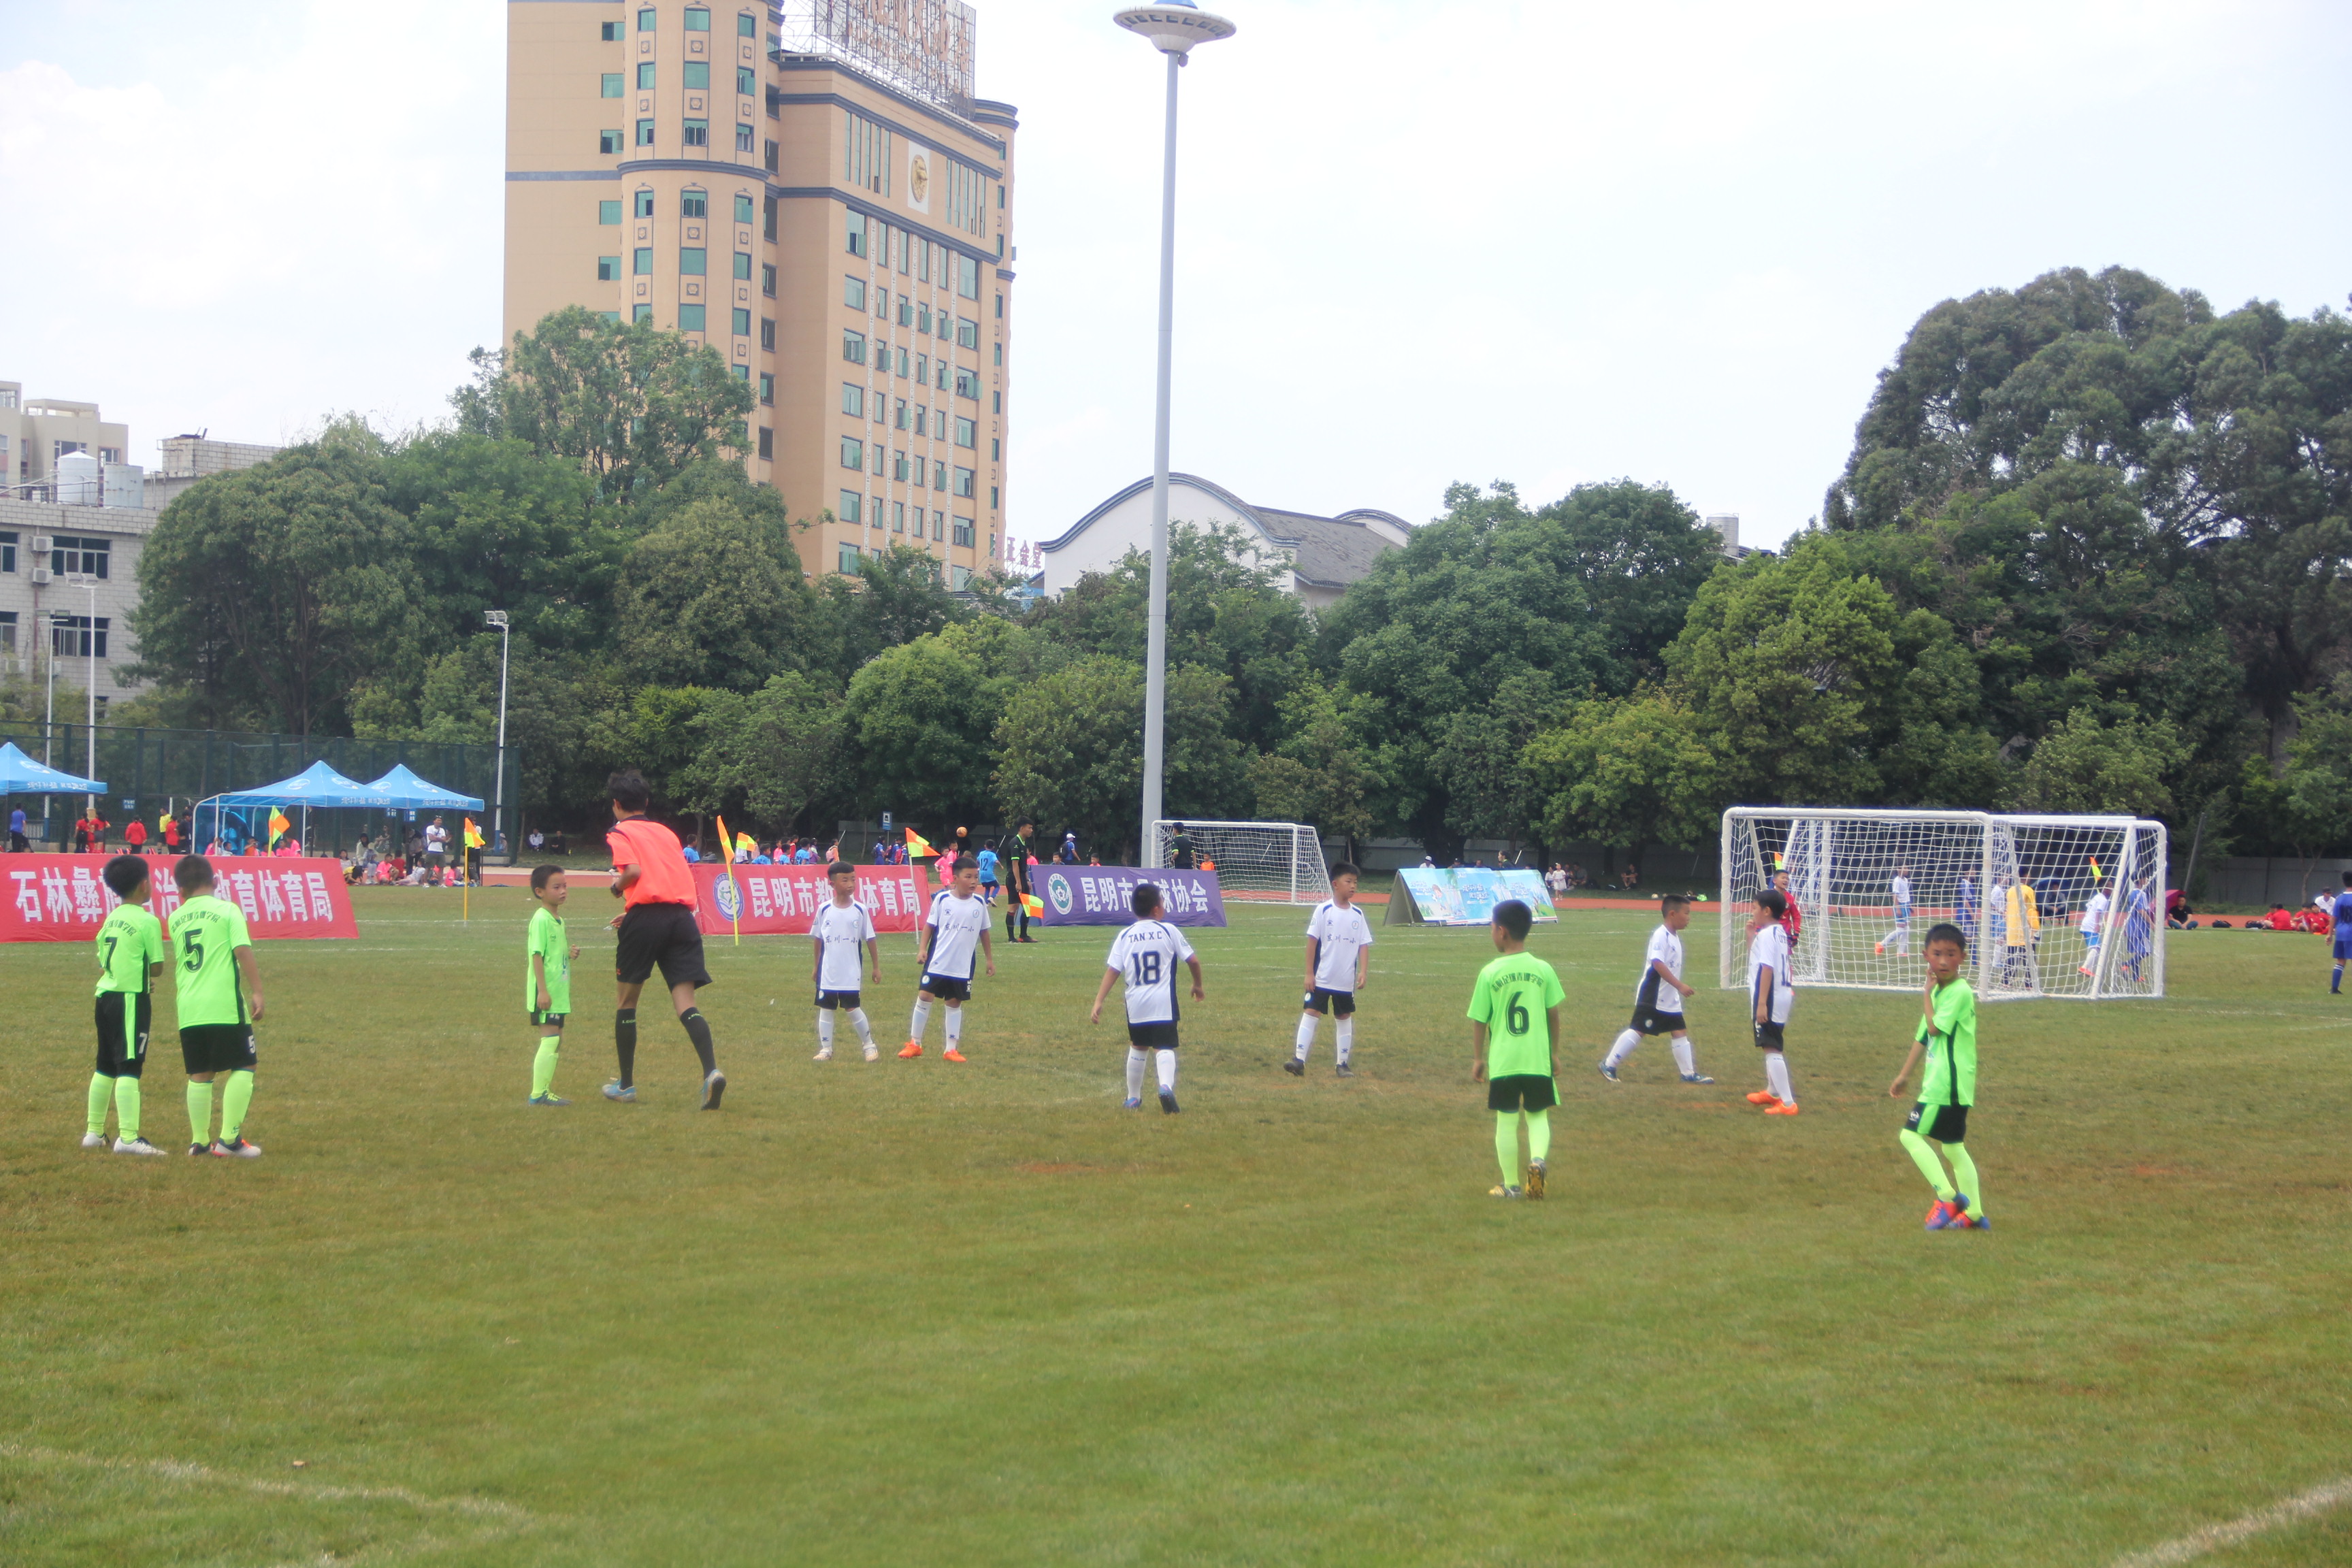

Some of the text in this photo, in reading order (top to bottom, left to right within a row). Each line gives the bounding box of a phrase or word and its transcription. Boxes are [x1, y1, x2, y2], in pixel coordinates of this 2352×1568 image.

[748, 877, 921, 918] 昆明市教体育局
[1080, 877, 1209, 913] 昆明市球协会
[825, 934, 858, 943] 东川一小
[945, 922, 975, 932] 东川一小
[1128, 931, 1162, 943] TAN X C
[103, 936, 118, 979] 7
[183, 928, 204, 973] 5
[1132, 951, 1160, 986] 18
[1505, 991, 1529, 1036] 6
[138, 1032, 148, 1054] 7
[248, 1035, 257, 1054] 5
